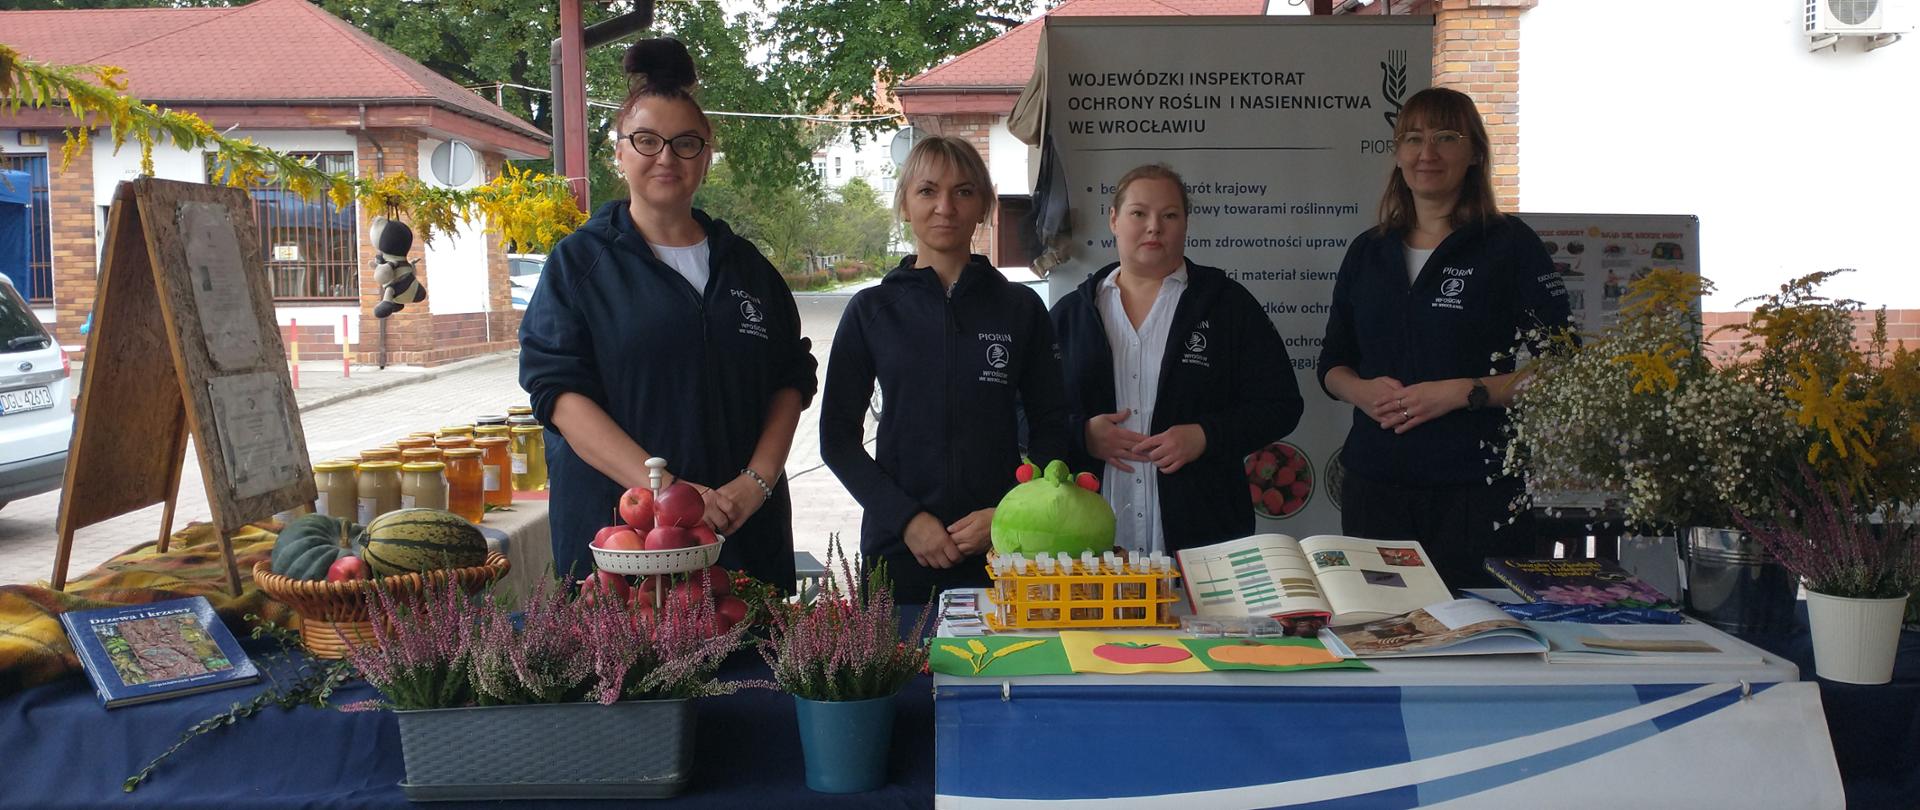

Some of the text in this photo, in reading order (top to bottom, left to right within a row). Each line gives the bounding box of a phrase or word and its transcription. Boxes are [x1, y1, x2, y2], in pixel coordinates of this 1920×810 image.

[1068, 69, 1306, 86] WOJEWÓDZKI INSPEKTORAT
[1068, 93, 1372, 110] OCHRONY ROŚLIN I NASIENNICTWA
[1068, 119, 1206, 134] WE WROCŁAWIU
[1360, 139, 1395, 154] PIOR
[1184, 181, 1267, 196] brót krajowy
[1100, 204, 1104, 215] i
[1224, 203, 1286, 215] towarami
[1290, 202, 1358, 217] roślinnymi
[1215, 235, 1302, 248] zdrowotności
[1306, 238, 1347, 250] upraw
[1241, 268, 1296, 281] materiał
[1299, 268, 1338, 281] siewn
[1262, 302, 1331, 314] dków ochr
[1285, 334, 1321, 347] ochro
[1, 389, 50, 410] DGL 42613
[89, 614, 137, 625] Drzewa
[148, 607, 192, 618] krzewy
